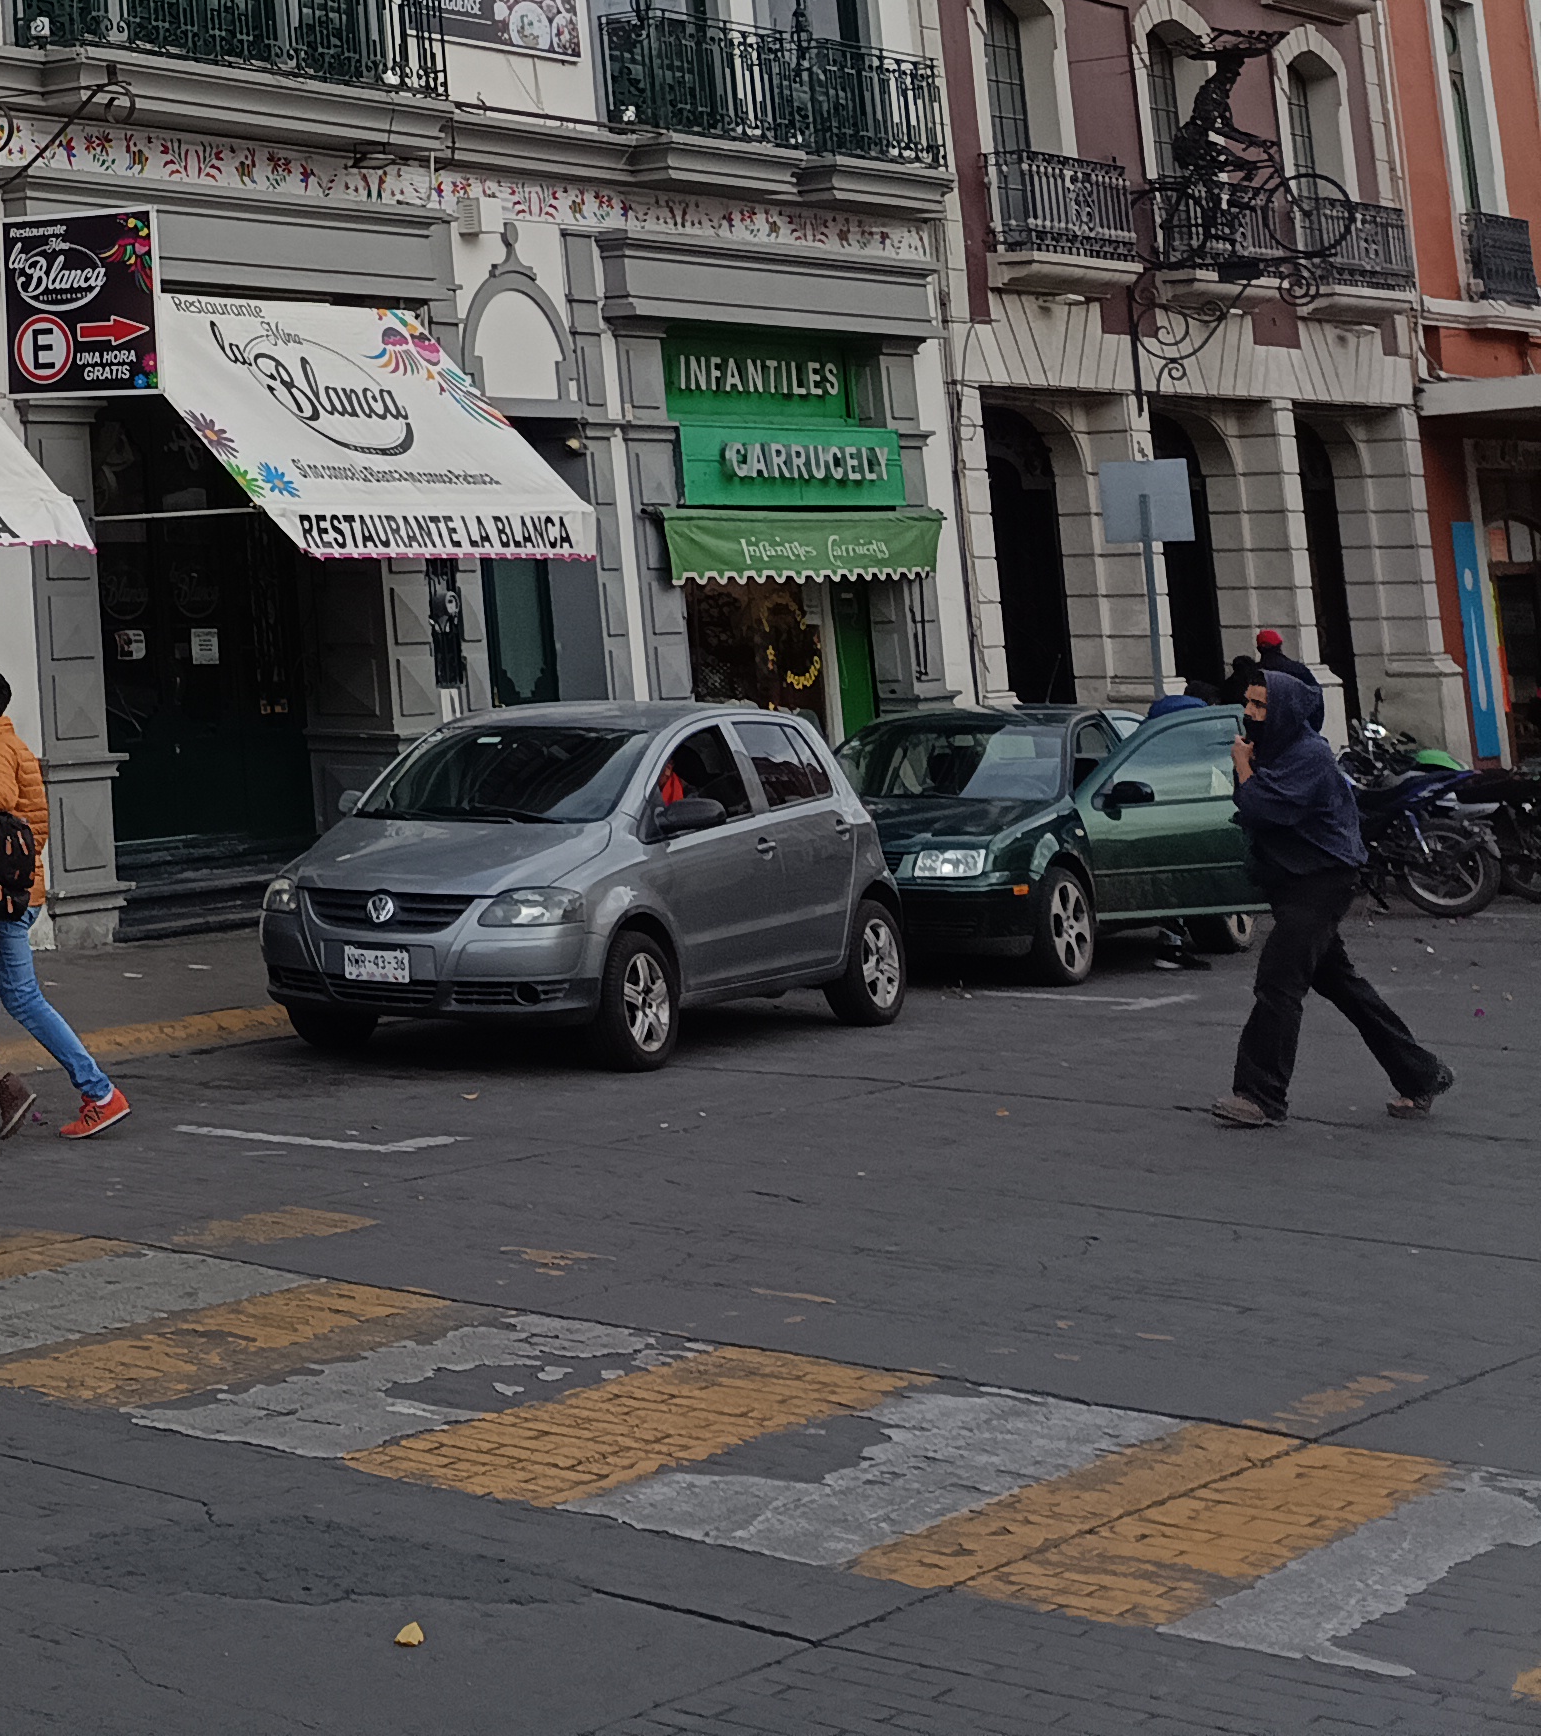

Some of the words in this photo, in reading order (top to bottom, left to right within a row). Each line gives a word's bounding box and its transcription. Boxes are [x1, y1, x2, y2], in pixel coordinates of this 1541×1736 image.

[9, 225, 67, 238] Restaurante
[8, 241, 25, 269] la
[17, 254, 106, 296] Blanca
[171, 296, 266, 319] Restaurante
[32, 328, 55, 370] E
[209, 320, 252, 367] la
[260, 321, 304, 346] Mina
[76, 352, 100, 365] UNA
[103, 350, 136, 364] HORA
[83, 365, 130, 380] GRATIS
[679, 354, 839, 396] INFANTILES
[253, 353, 409, 421] Blanca
[728, 441, 889, 482] CARRUCELY
[299, 514, 463, 549] RESTAURANTE
[461, 514, 495, 549] LA
[492, 514, 574, 549] BLANCA
